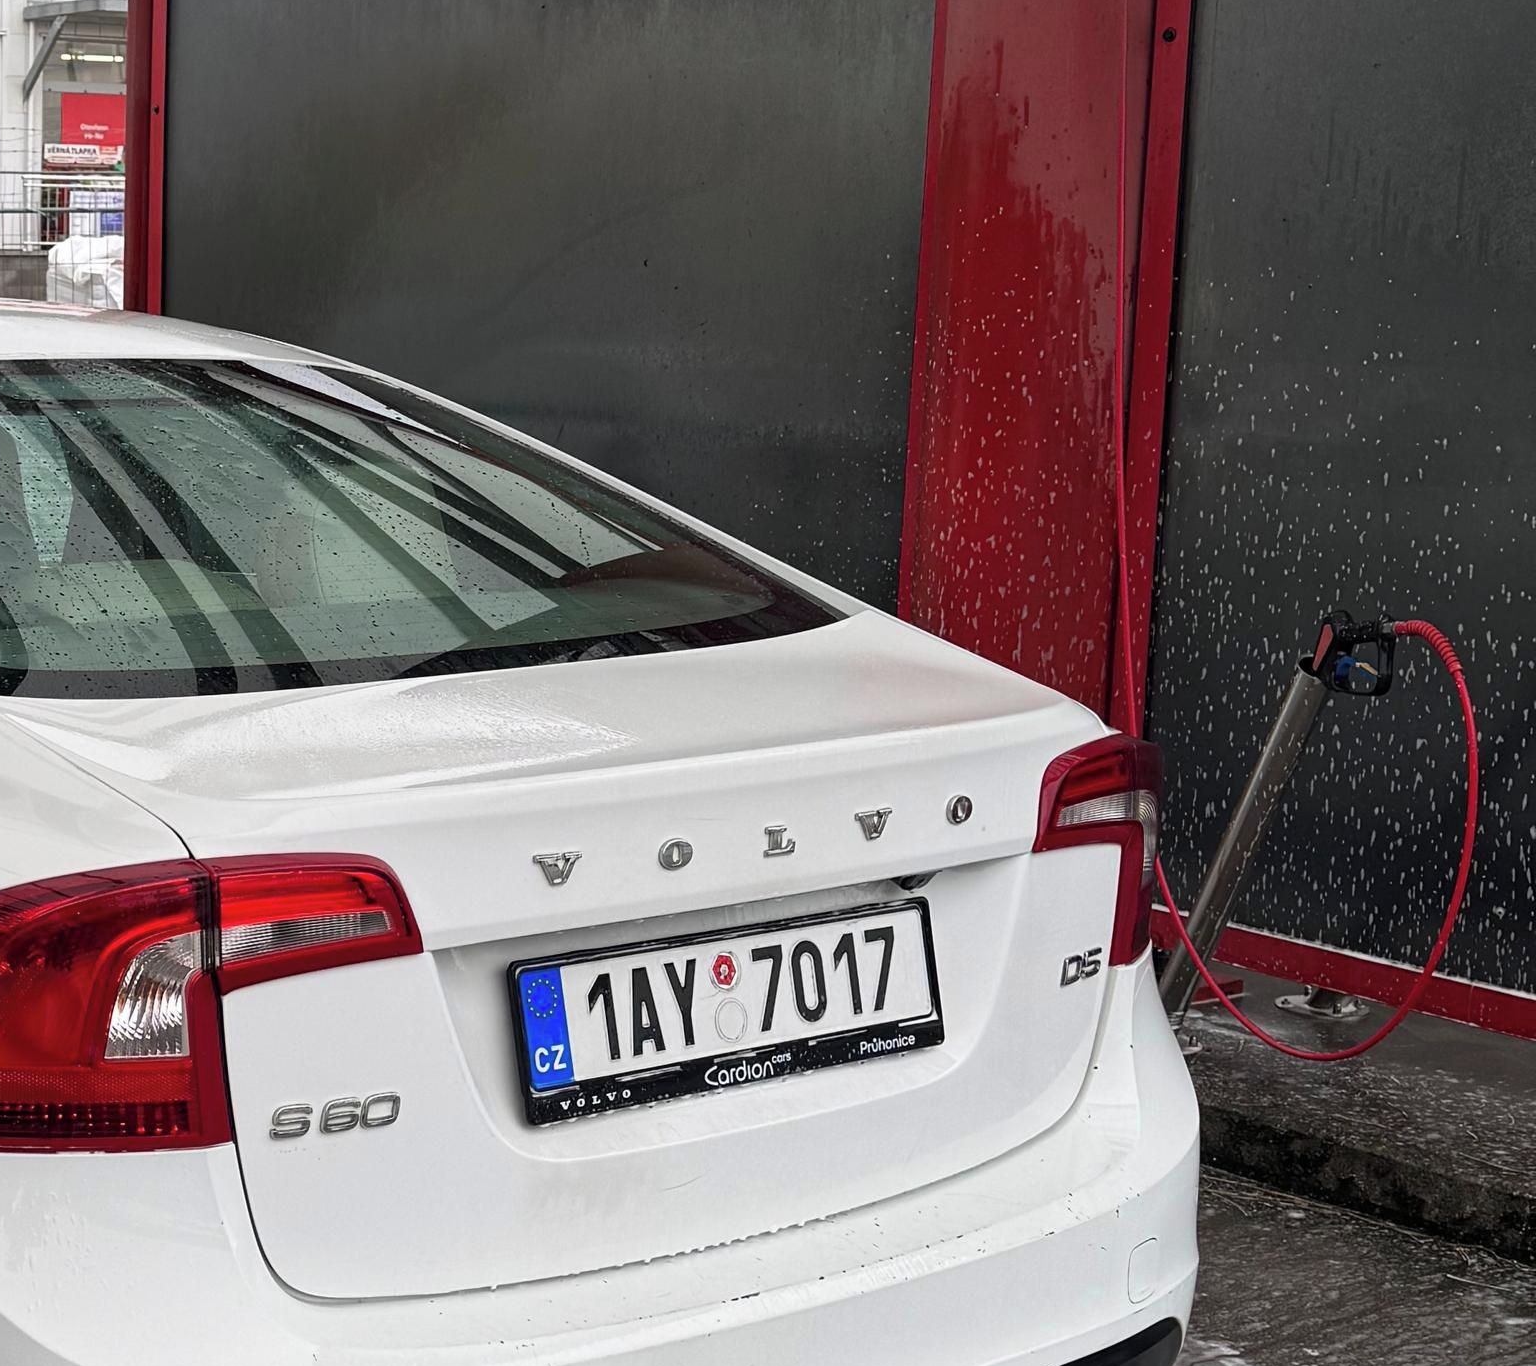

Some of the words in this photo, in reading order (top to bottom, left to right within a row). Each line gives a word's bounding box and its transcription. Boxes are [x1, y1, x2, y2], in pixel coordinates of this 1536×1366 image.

[533, 794, 973, 886] VOLVO
[1060, 946, 1103, 987] D5
[587, 958, 697, 1060] 1AY
[751, 926, 895, 1032] 7017
[534, 1044, 567, 1074] CZ
[704, 1060, 774, 1086] Cardion
[771, 1052, 792, 1064] cars
[561, 1088, 633, 1111] VOLVO
